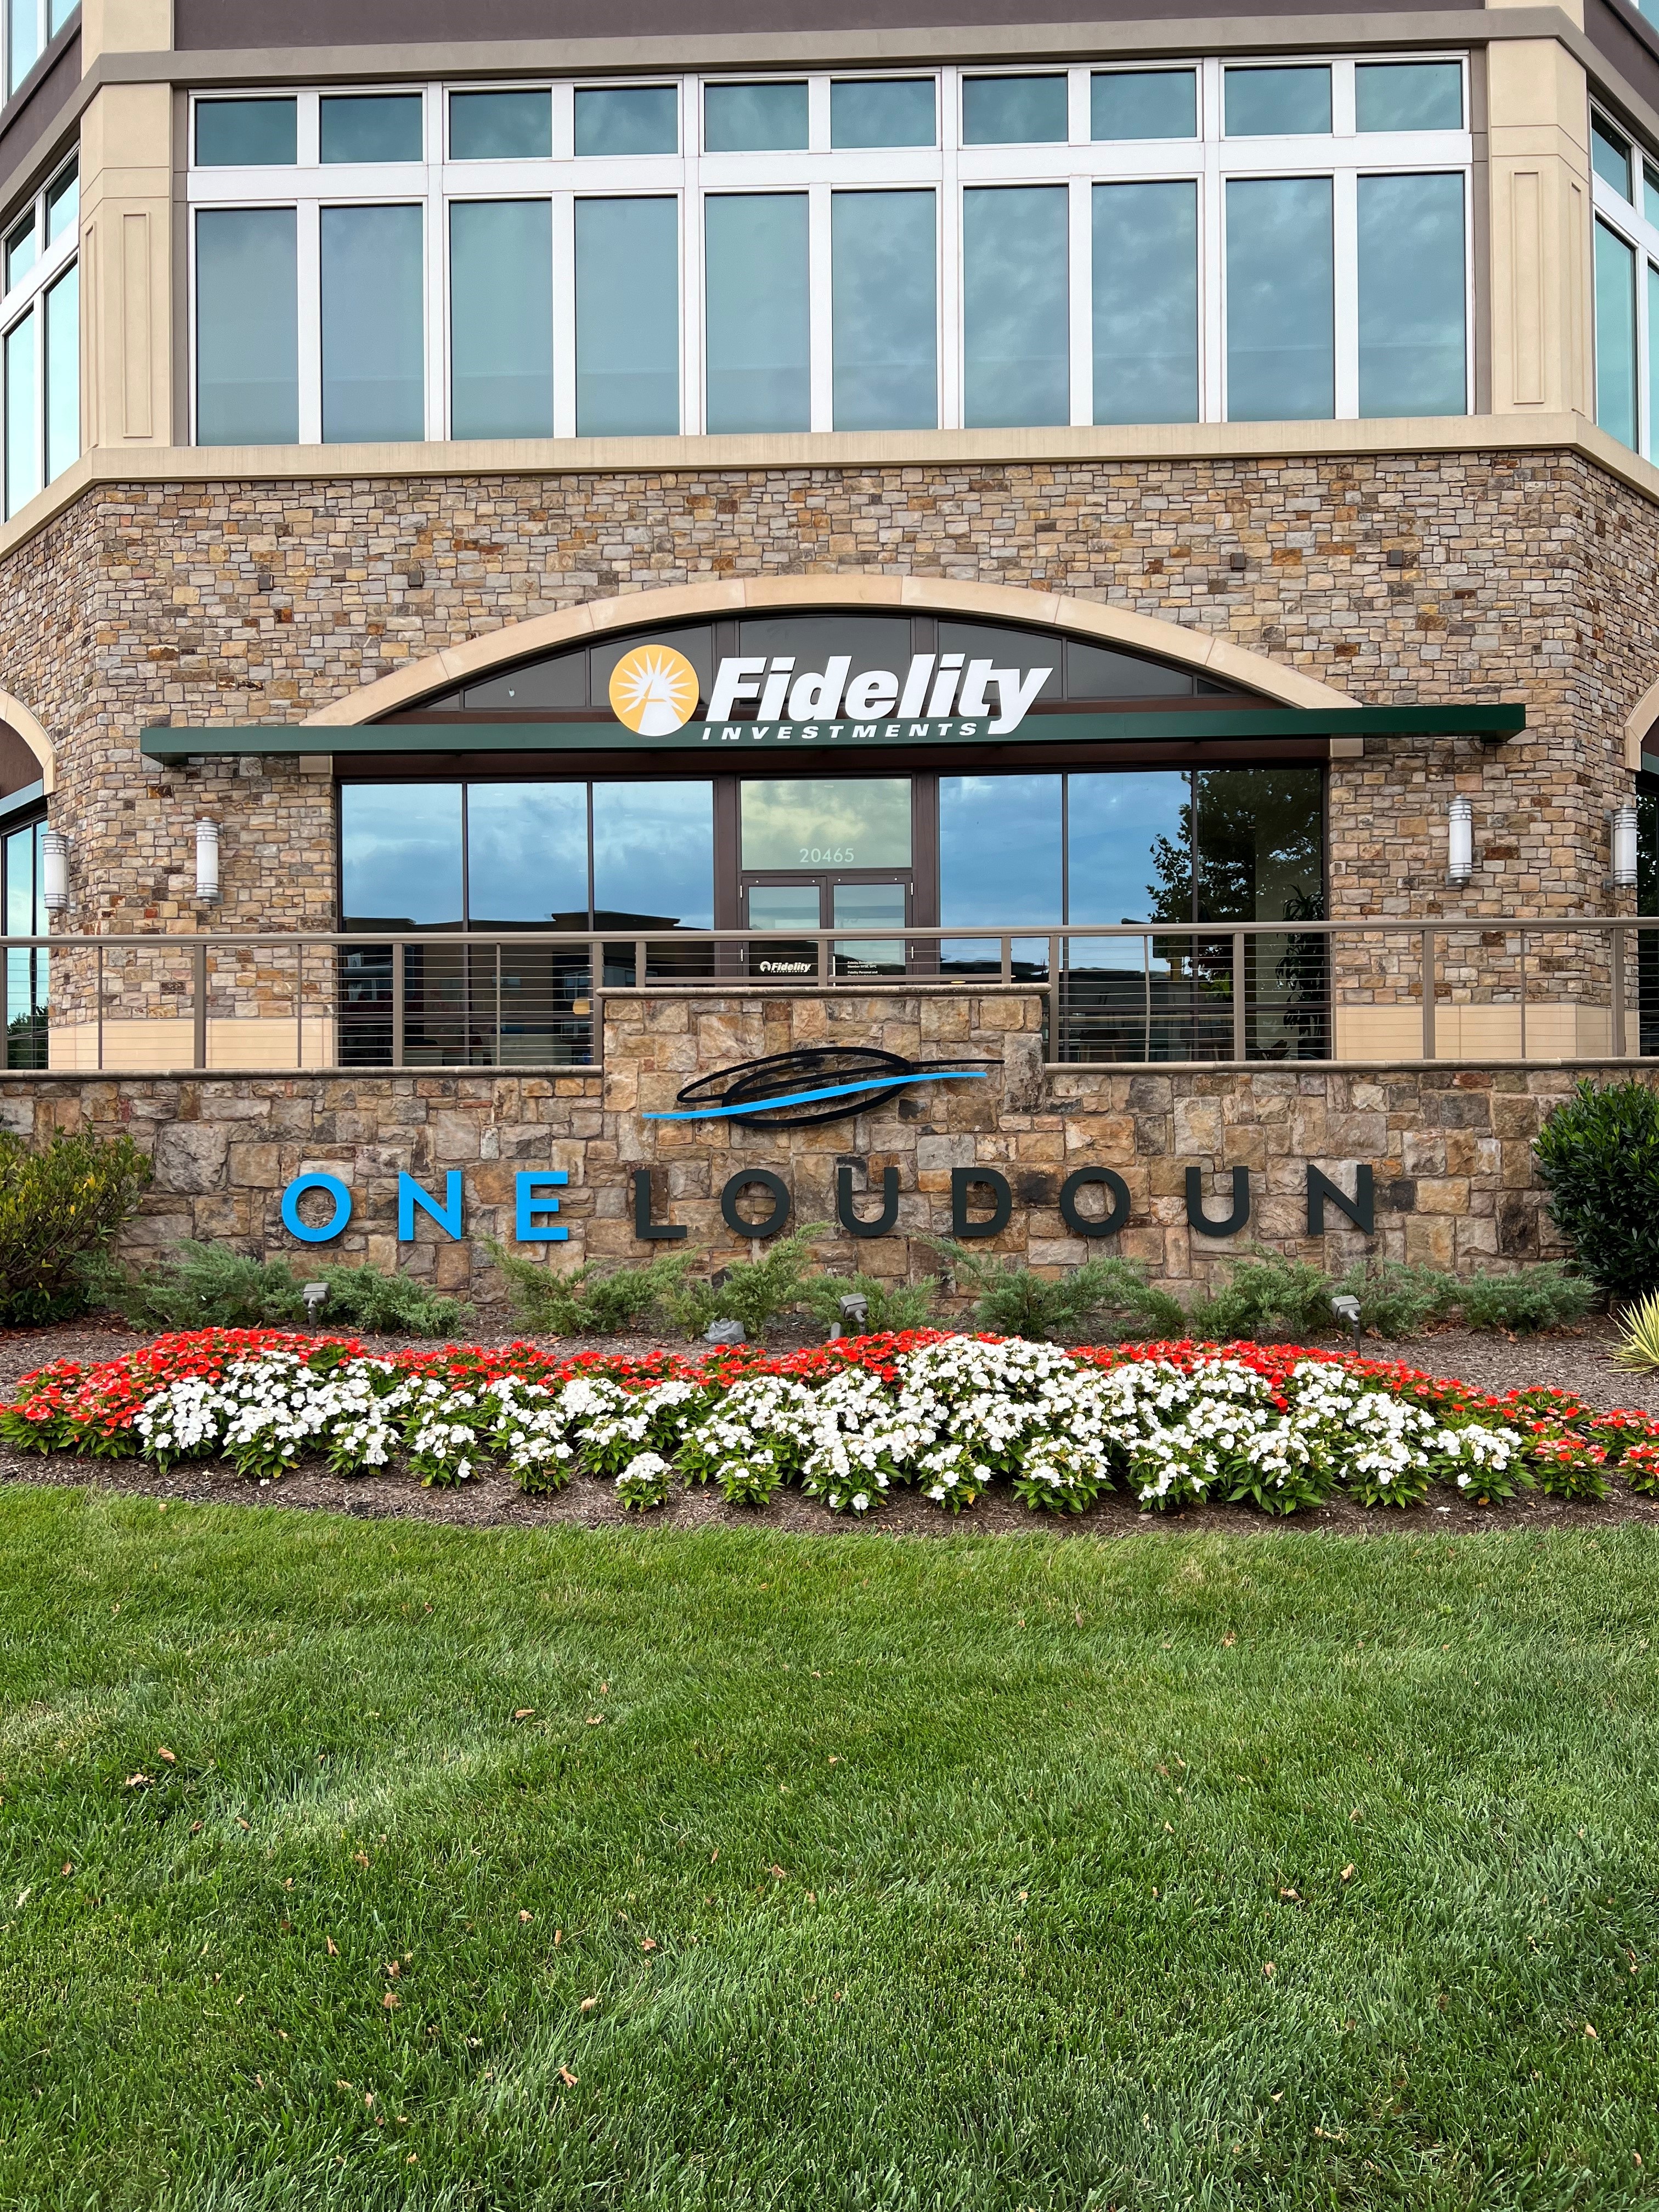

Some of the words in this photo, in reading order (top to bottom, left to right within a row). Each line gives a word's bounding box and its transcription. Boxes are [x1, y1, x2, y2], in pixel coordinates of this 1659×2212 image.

[705, 653, 1053, 735] Fidelity
[702, 723, 977, 740] INVESTMENTS
[799, 848, 854, 863] 20465
[771, 962, 811, 973] Fidelity
[280, 1170, 568, 1242] ONE
[635, 1164, 1374, 1238] LOUDOUN
